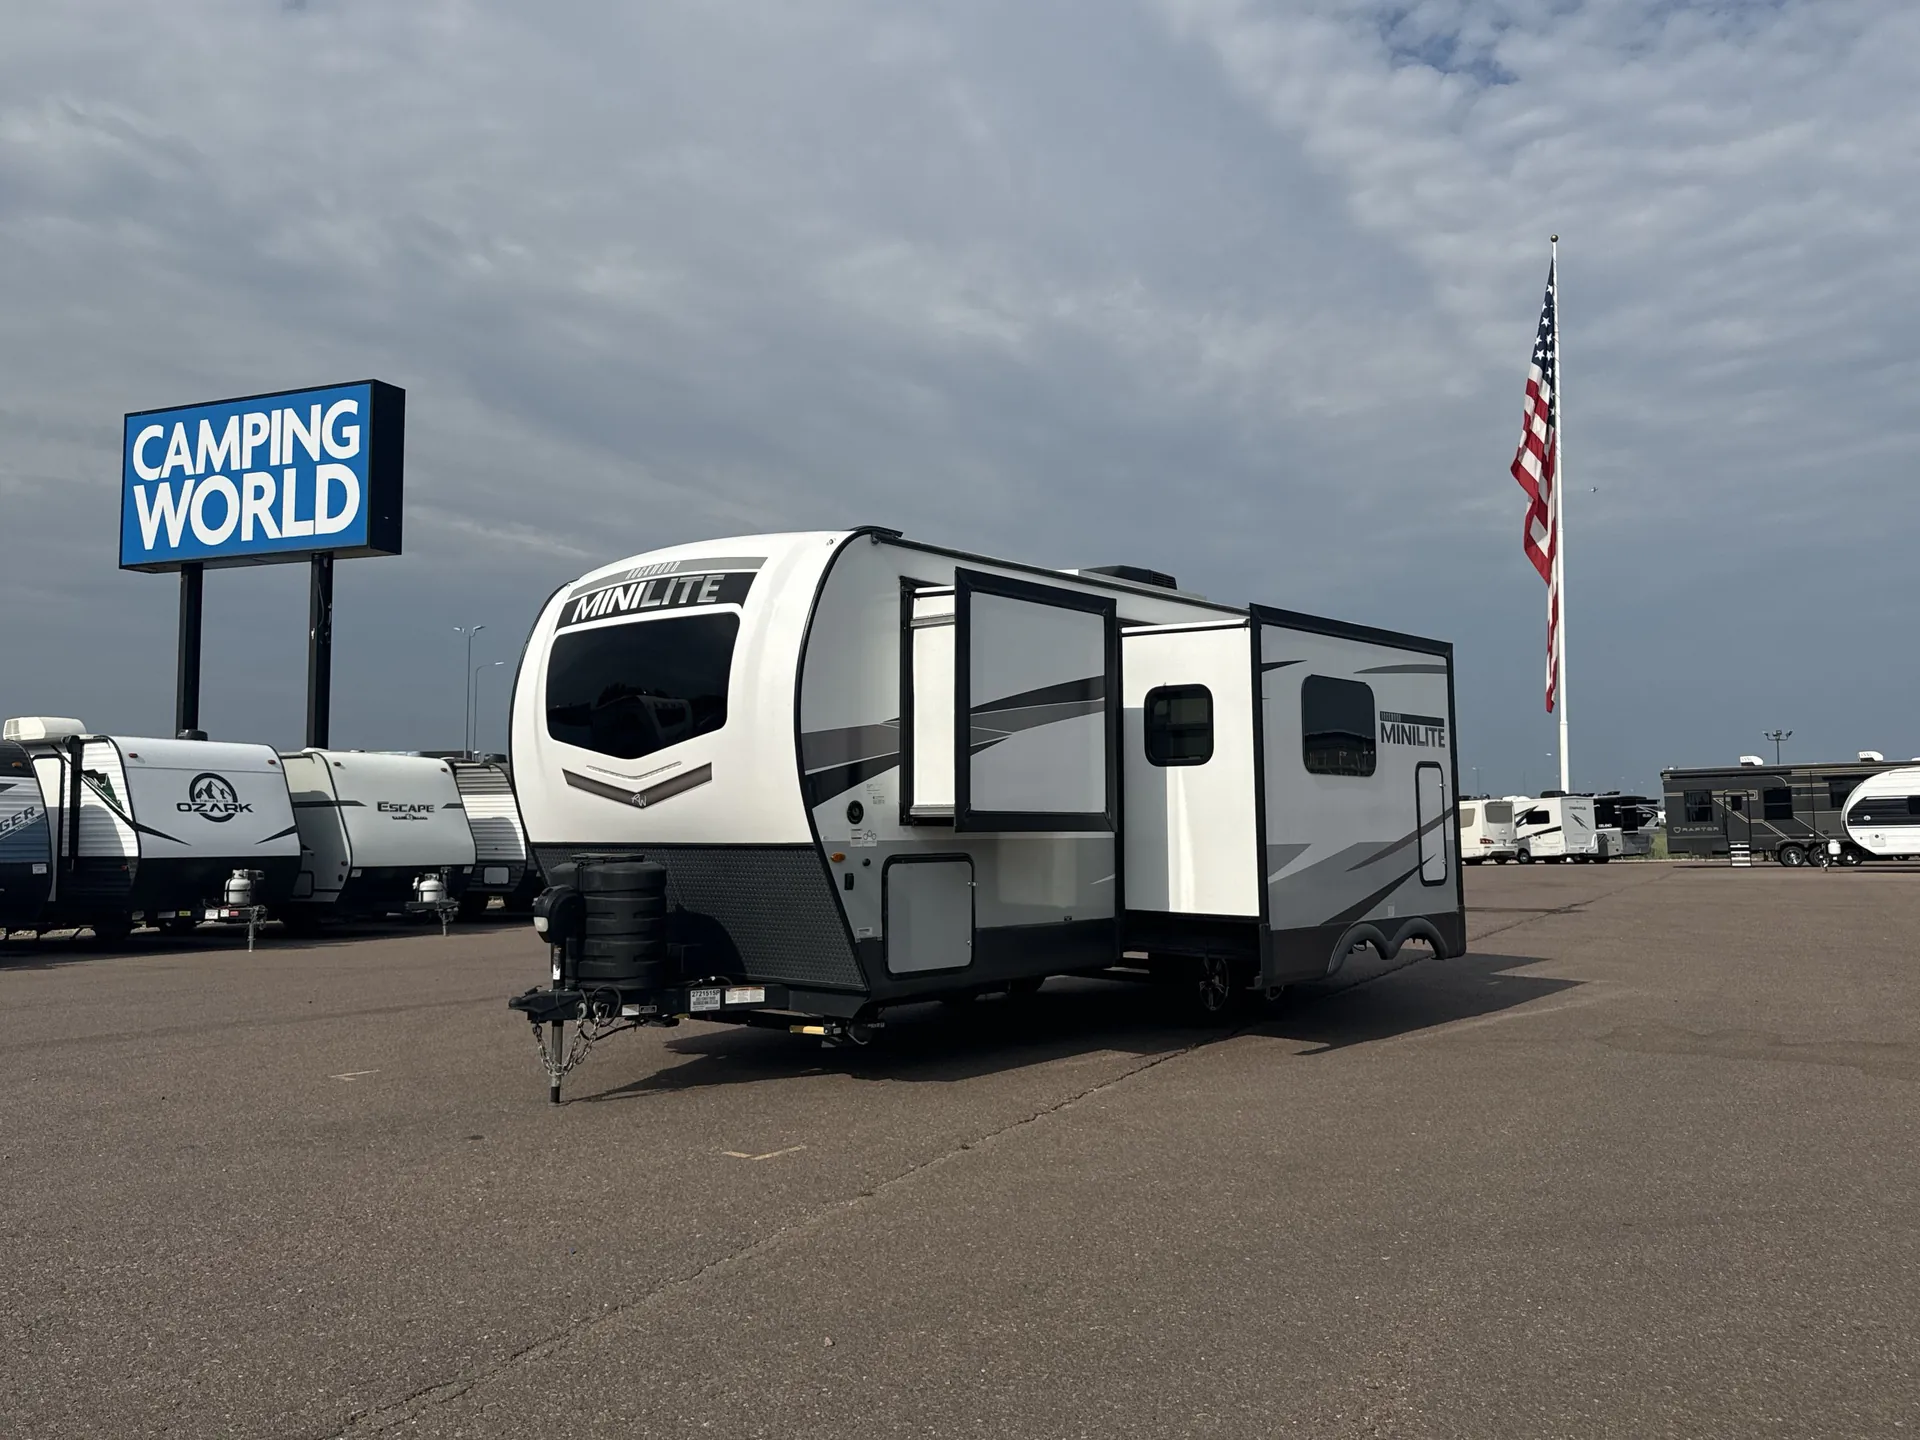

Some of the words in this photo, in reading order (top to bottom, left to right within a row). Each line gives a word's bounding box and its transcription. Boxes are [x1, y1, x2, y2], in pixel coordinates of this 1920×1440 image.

[133, 399, 360, 481] CAMPING
[133, 463, 360, 550] WORLD
[571, 574, 725, 623] MINILITE
[1380, 722, 1446, 748] MINILITE
[176, 802, 254, 813] OZARK
